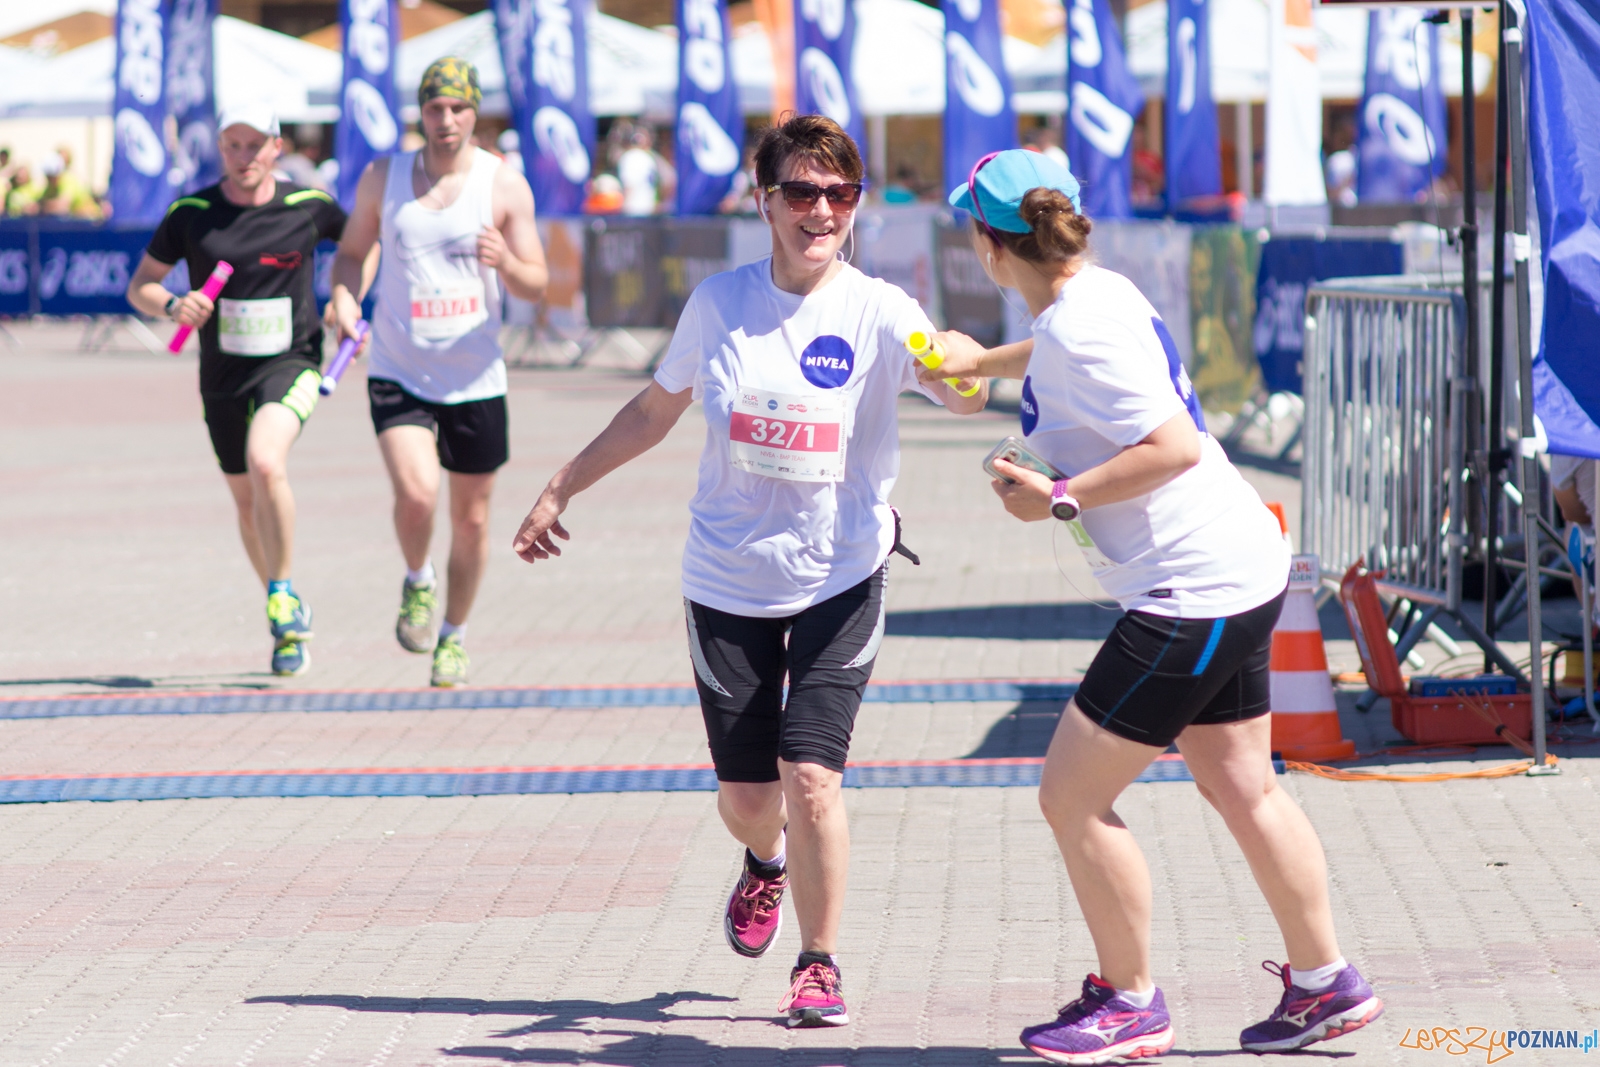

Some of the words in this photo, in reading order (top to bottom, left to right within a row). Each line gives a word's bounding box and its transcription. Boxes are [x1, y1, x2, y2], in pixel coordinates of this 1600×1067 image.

[421, 297, 470, 317] 101/1
[805, 356, 849, 371] NIVEA
[750, 418, 815, 449] 32/1
[760, 450, 776, 459] NIVEA
[780, 453, 790, 461] BMP
[791, 454, 806, 462] TEAM
